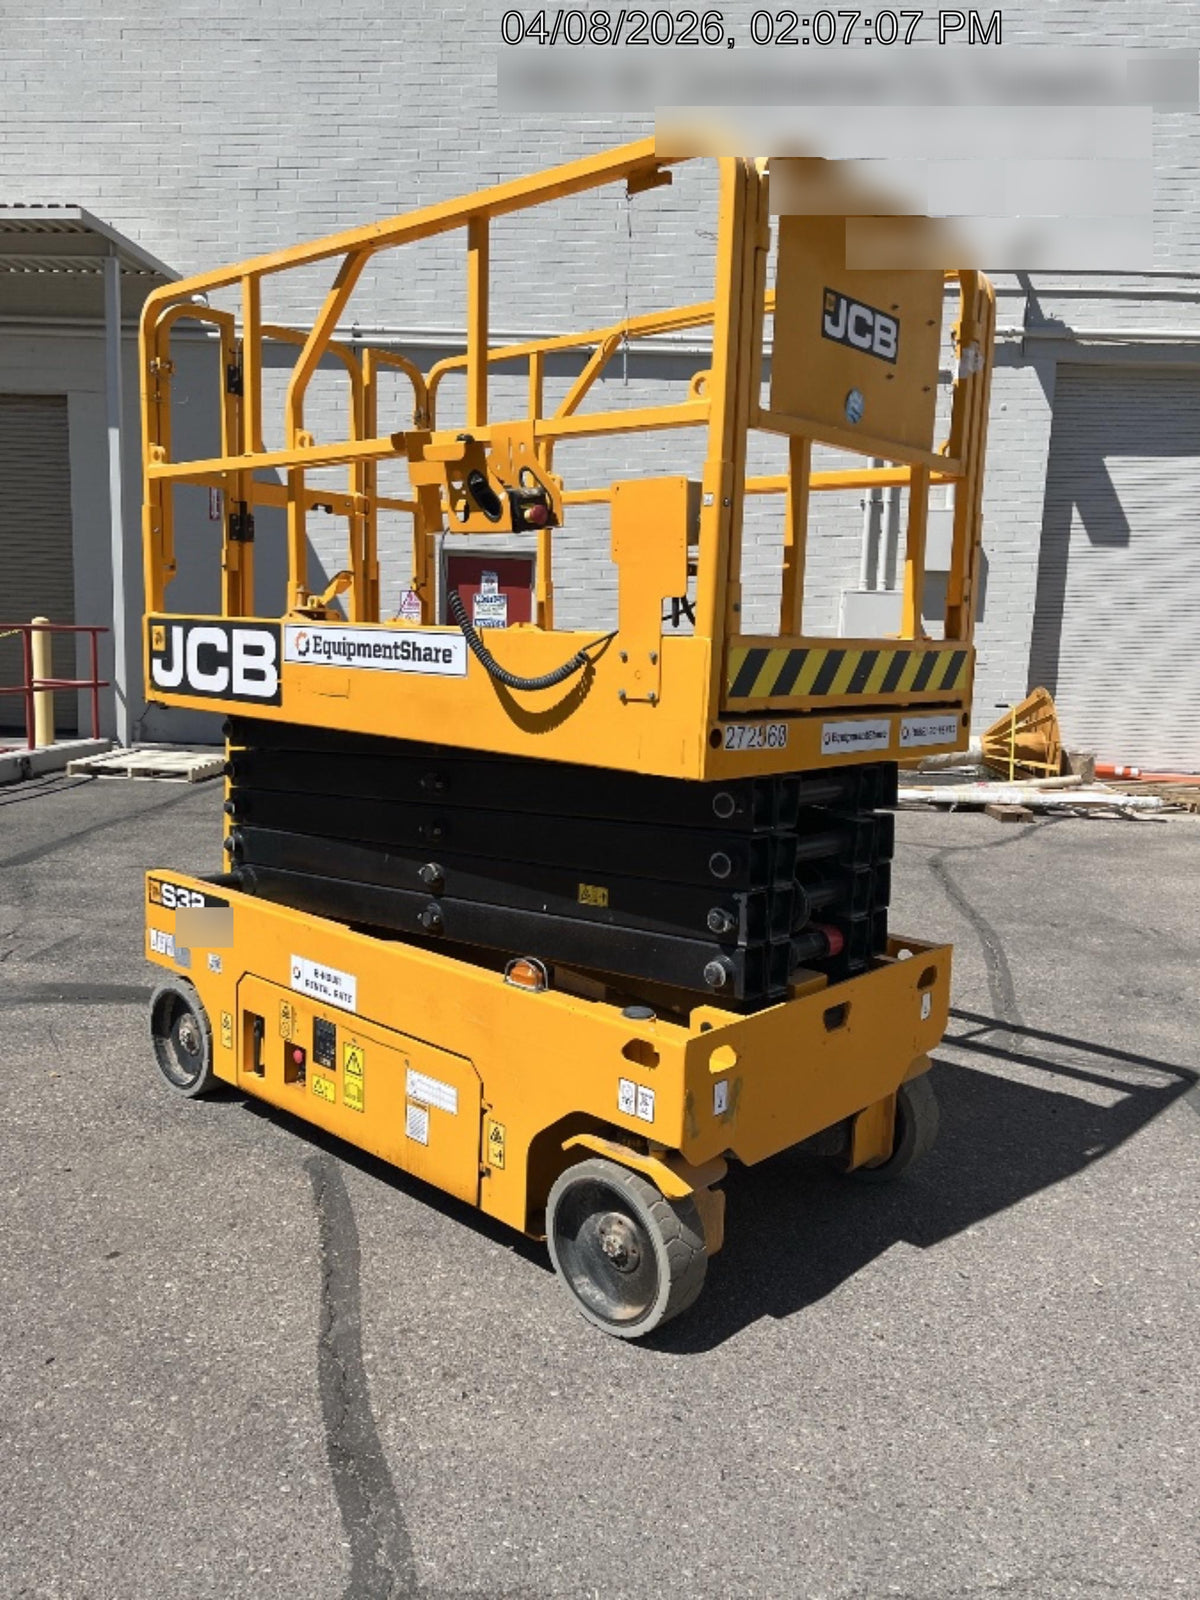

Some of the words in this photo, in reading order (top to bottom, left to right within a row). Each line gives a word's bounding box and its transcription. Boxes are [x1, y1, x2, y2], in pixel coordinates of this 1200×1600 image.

[824, 298, 897, 359] JCB
[152, 625, 278, 697] JCB
[312, 635, 452, 665] EquipmentShare
